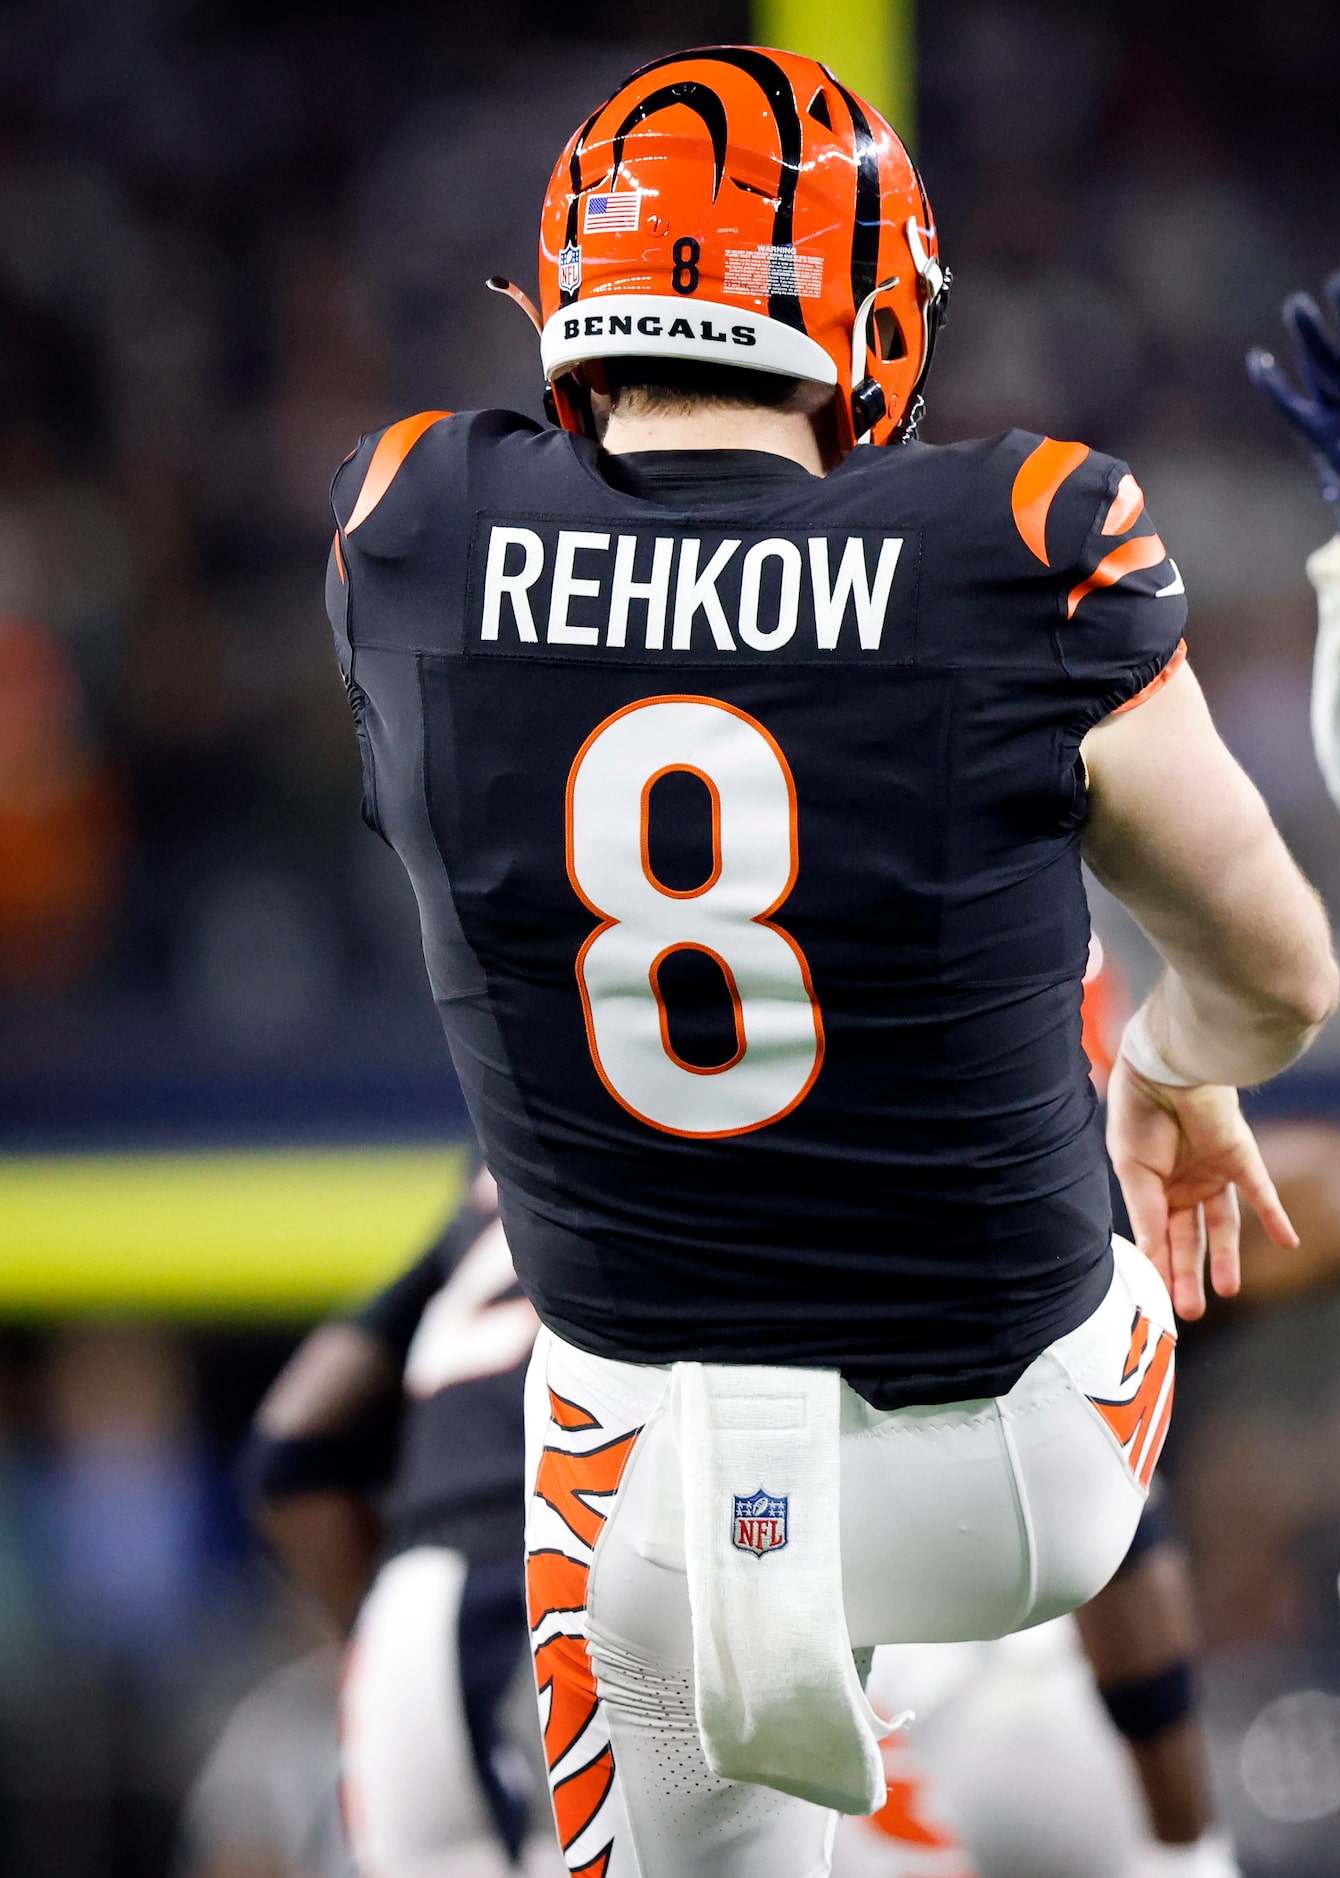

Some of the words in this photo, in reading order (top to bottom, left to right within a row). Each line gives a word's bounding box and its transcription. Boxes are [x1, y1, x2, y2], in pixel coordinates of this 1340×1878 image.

[672, 236, 700, 295] 8
[757, 245, 797, 255] WARNING
[561, 265, 578, 286] NFL
[564, 315, 756, 346] BENGALS
[480, 526, 904, 652] REHKOW
[565, 694, 825, 1139] 8
[738, 1519, 783, 1551] NFL
